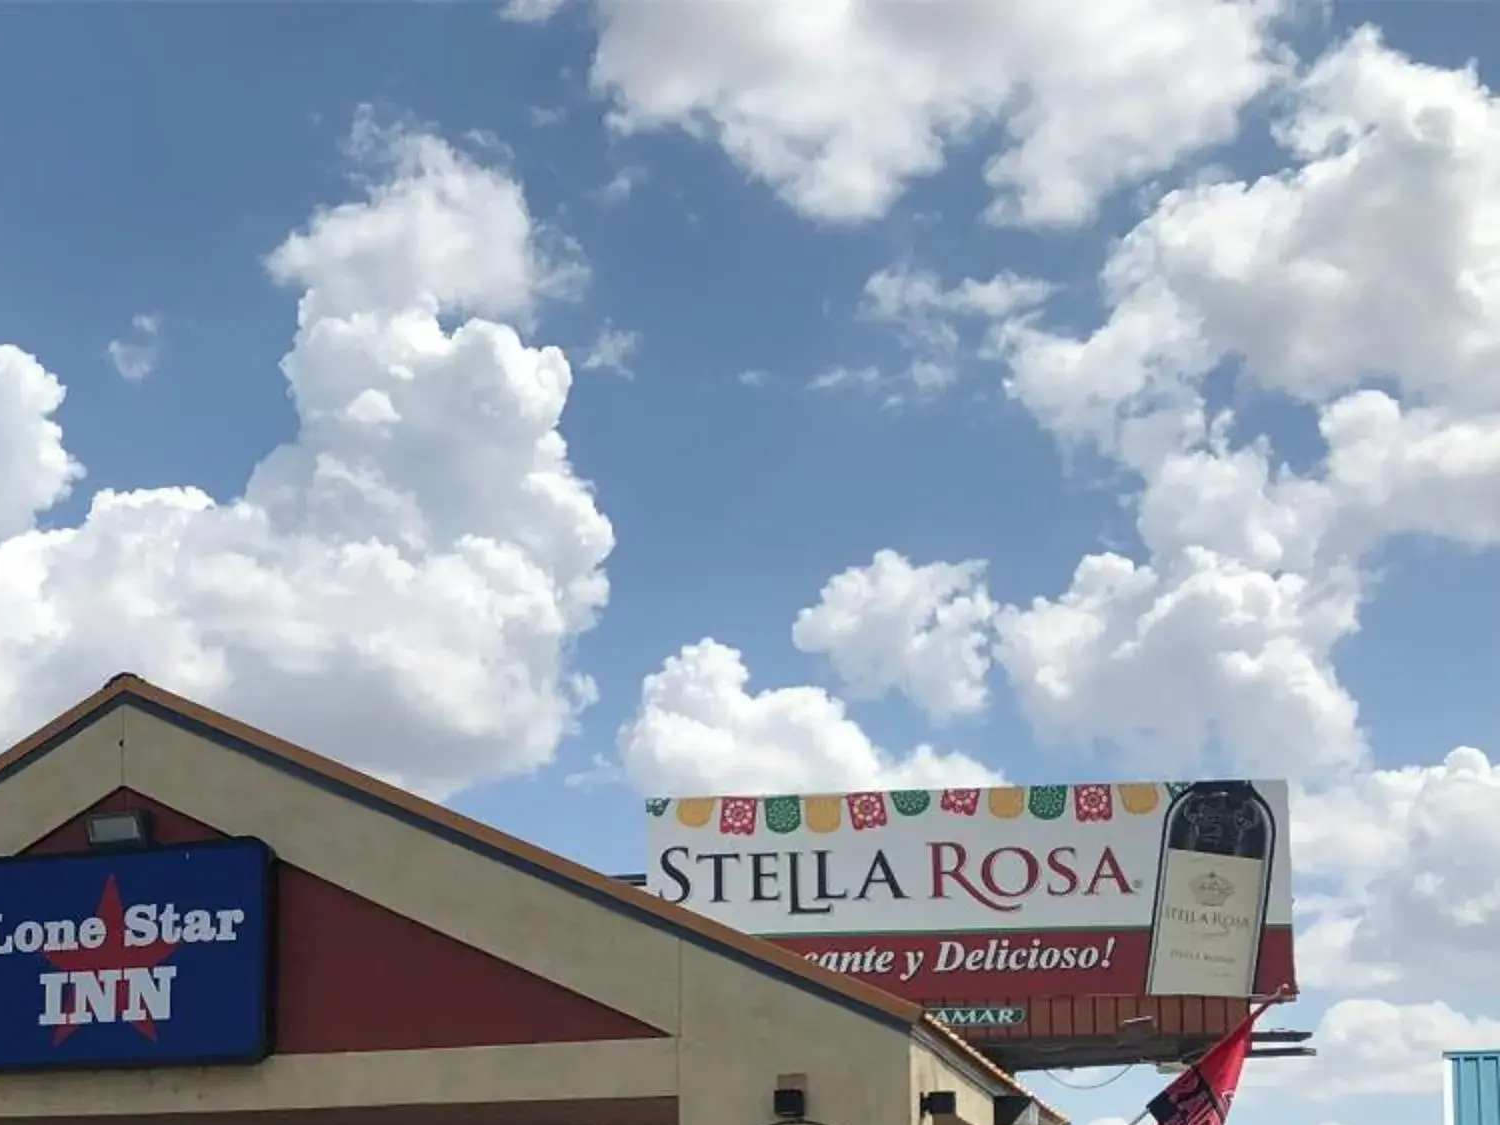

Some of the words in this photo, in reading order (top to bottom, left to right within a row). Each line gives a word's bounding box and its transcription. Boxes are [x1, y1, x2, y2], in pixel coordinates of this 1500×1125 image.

[659, 845, 911, 915] STELLA
[925, 841, 1135, 912] ROSA
[124, 903, 244, 946] Star
[900, 950, 925, 981] y
[933, 936, 1117, 973] Delicioso!
[38, 966, 177, 1025] INN
[934, 1008, 1015, 1025] AMAR
